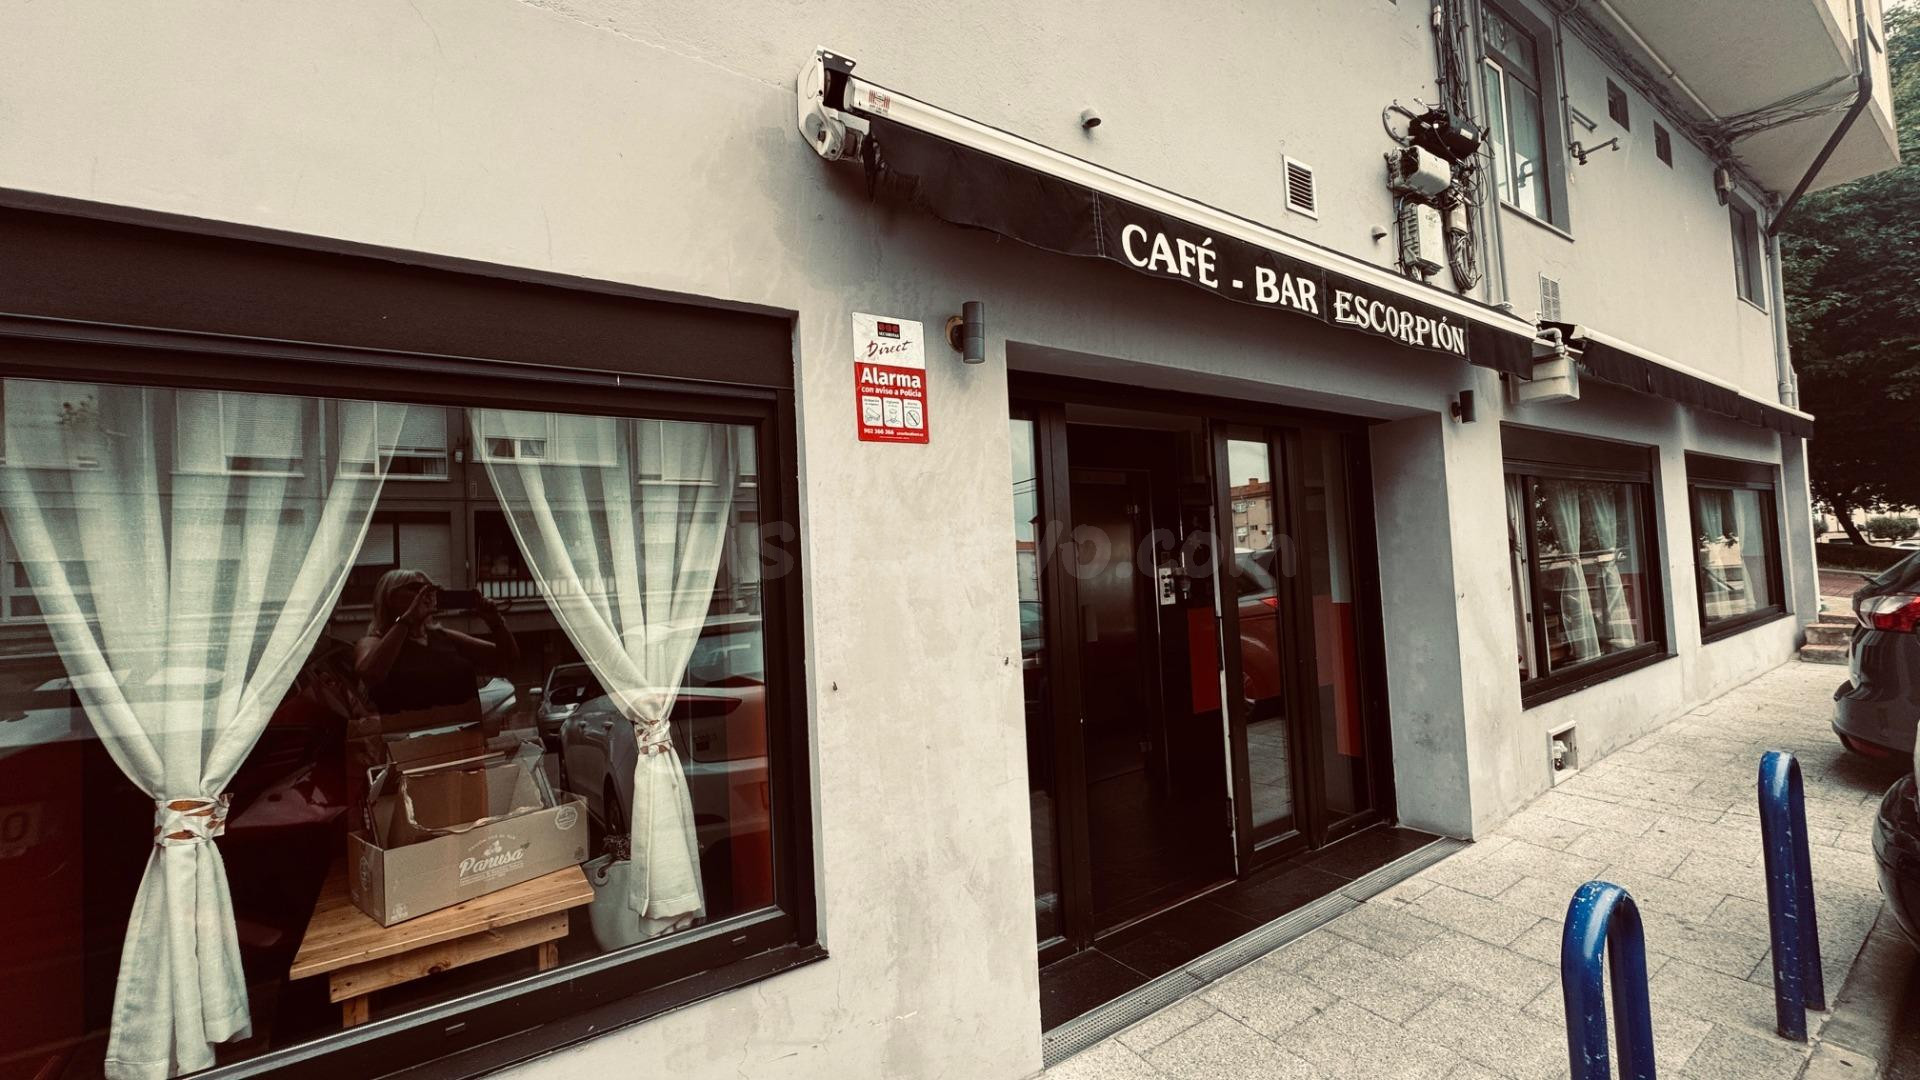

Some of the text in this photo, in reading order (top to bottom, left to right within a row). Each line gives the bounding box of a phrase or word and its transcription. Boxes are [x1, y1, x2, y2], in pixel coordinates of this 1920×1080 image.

[1121, 224, 1218, 289] CAFÉ
[1255, 266, 1319, 314] BAR
[1334, 289, 1466, 355] ESCORPIÓN
[861, 367, 922, 389] Alarma
[875, 386, 893, 395] aviso
[459, 848, 523, 878] Panusa
